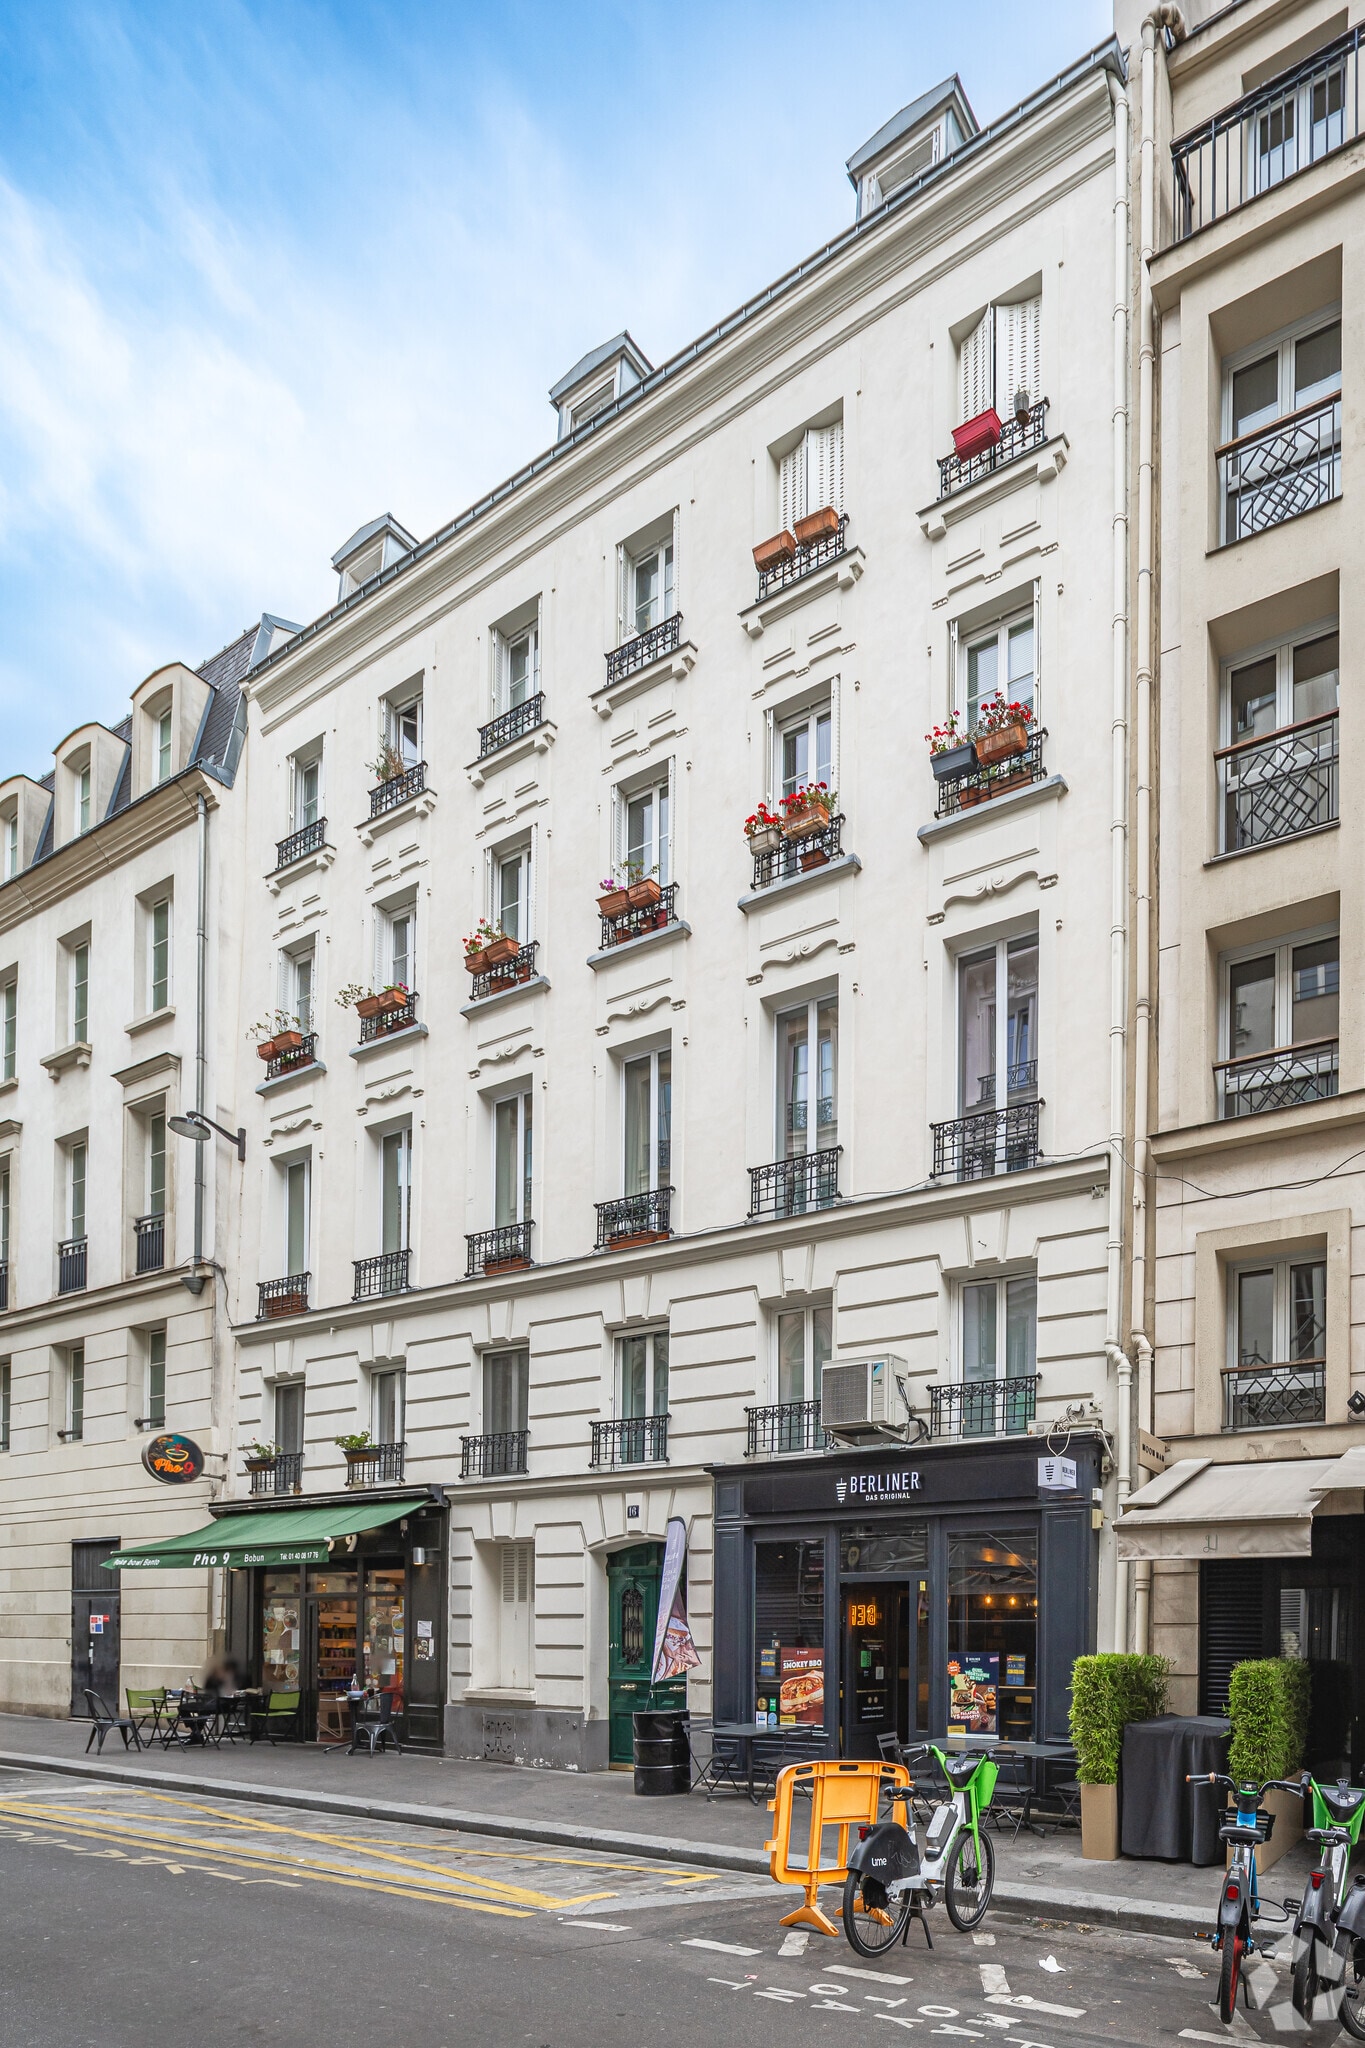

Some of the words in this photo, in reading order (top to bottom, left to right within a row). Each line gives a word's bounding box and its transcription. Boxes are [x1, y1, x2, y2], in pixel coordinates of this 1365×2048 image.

[154, 1458, 183, 1474] Pho
[183, 1463, 194, 1475] 9
[850, 1471, 920, 1494] BERLINER
[880, 1492, 911, 1500] ORIGINAL
[628, 1506, 637, 1517] 16
[127, 1558, 143, 1566] bowl
[143, 1558, 161, 1566] Bento
[192, 1553, 217, 1566] Pho
[223, 1551, 230, 1565] 9
[244, 1553, 265, 1563] Bobun
[783, 1660, 808, 1669] SMOKEY
[809, 1659, 822, 1667] BBQ
[871, 1857, 888, 1867] Lime
[808, 1982, 1023, 2030] MOTO
